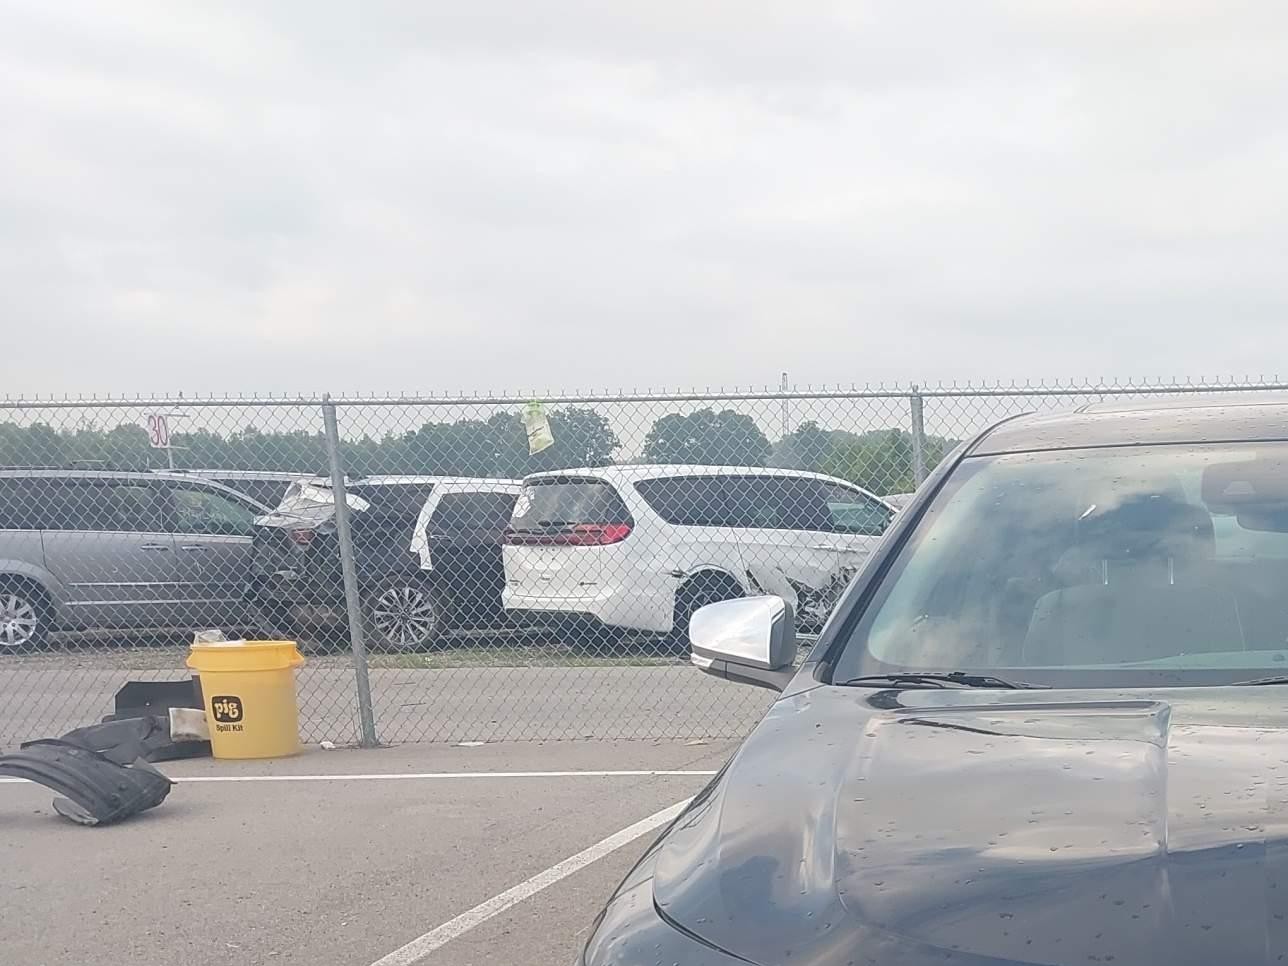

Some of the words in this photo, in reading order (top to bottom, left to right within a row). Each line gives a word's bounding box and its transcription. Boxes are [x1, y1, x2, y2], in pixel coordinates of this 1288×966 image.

[213, 698, 240, 719] pig
[215, 724, 231, 733] Spill
[232, 724, 244, 732] Kit
